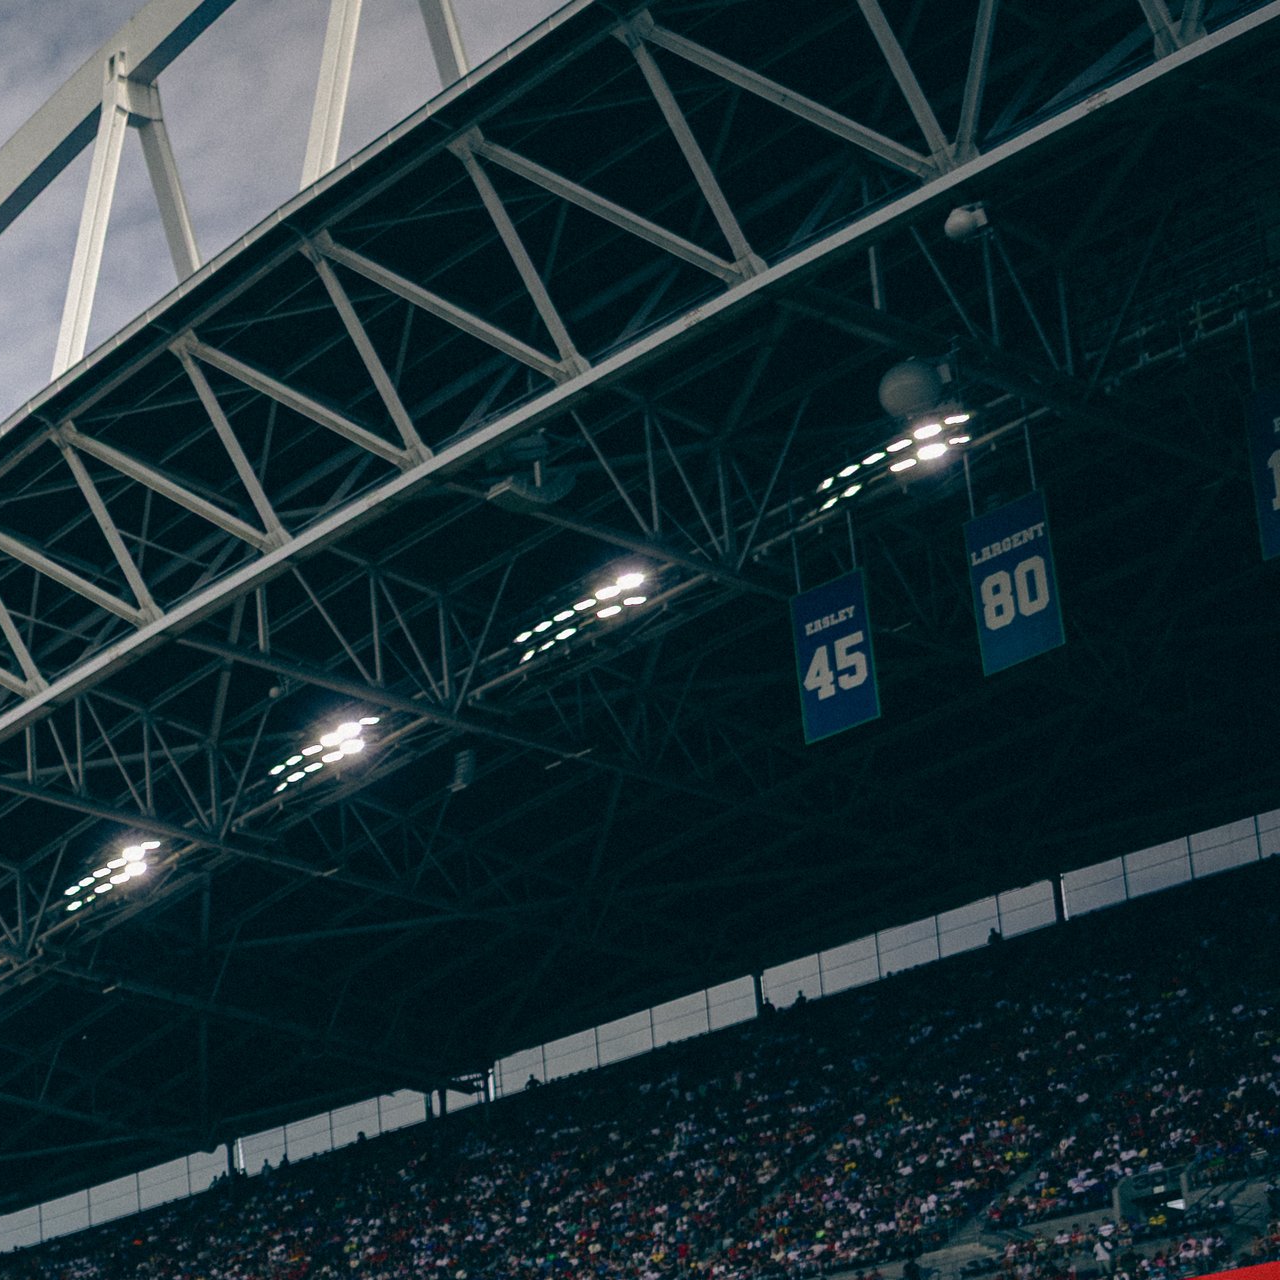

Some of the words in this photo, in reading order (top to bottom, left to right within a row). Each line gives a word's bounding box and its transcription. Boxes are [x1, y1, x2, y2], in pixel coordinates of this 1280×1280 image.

[971, 522, 1045, 566] LARGENT
[805, 605, 855, 636] EASLEY
[981, 555, 1050, 631] 80
[803, 630, 868, 701] 45
